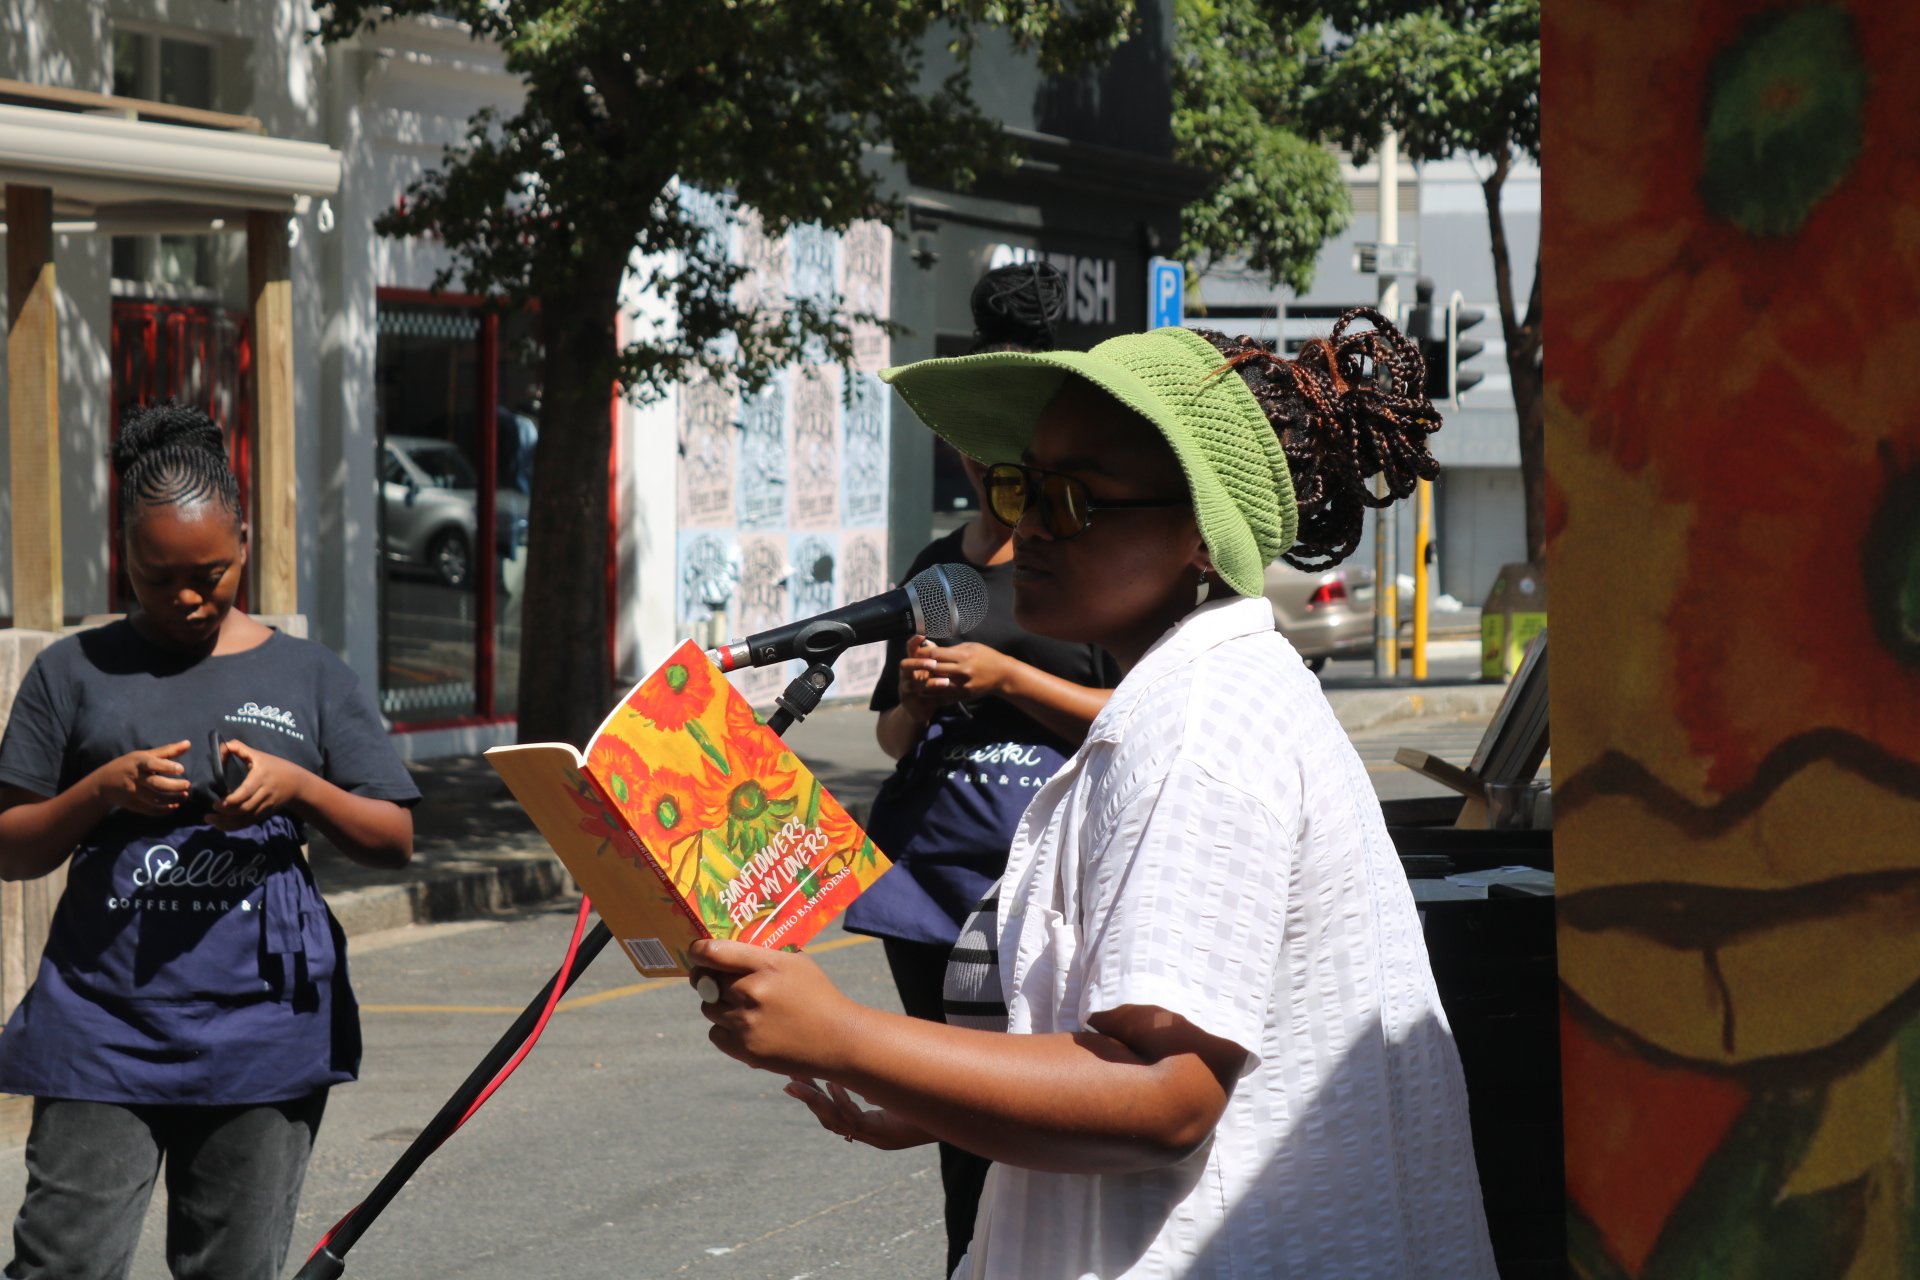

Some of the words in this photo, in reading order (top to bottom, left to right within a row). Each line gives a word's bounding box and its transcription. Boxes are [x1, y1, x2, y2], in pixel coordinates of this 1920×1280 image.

[1160, 270, 1176, 312] P
[719, 816, 806, 910] SUNFLOWERS
[730, 892, 766, 930] FOR
[759, 869, 782, 900] MY
[776, 827, 829, 884] LOVERS
[108, 897, 179, 911] COFFEE
[193, 900, 230, 911] BAR
[241, 899, 251, 911] &
[761, 915, 798, 948] ZIZIPHO
